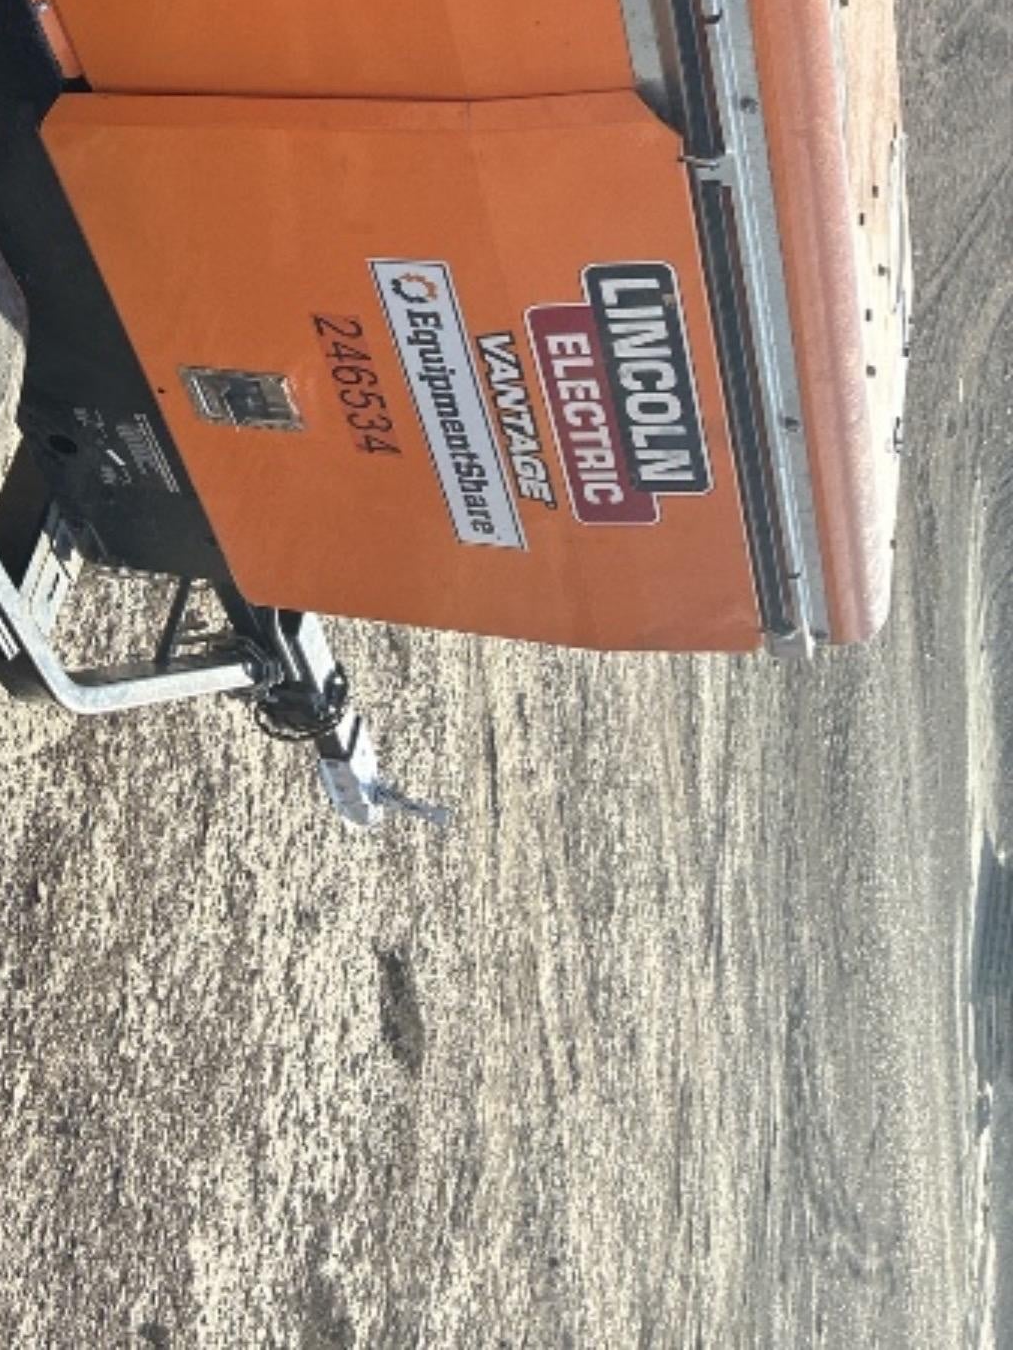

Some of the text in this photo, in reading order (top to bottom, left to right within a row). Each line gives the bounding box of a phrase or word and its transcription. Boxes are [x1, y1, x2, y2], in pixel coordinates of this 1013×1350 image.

[312, 313, 401, 455] 246534
[406, 307, 495, 535] EquipmentShare
[476, 331, 554, 505] VANTAGE
[545, 332, 625, 505] ELECTRIC
[599, 278, 696, 481] LINCOLN
